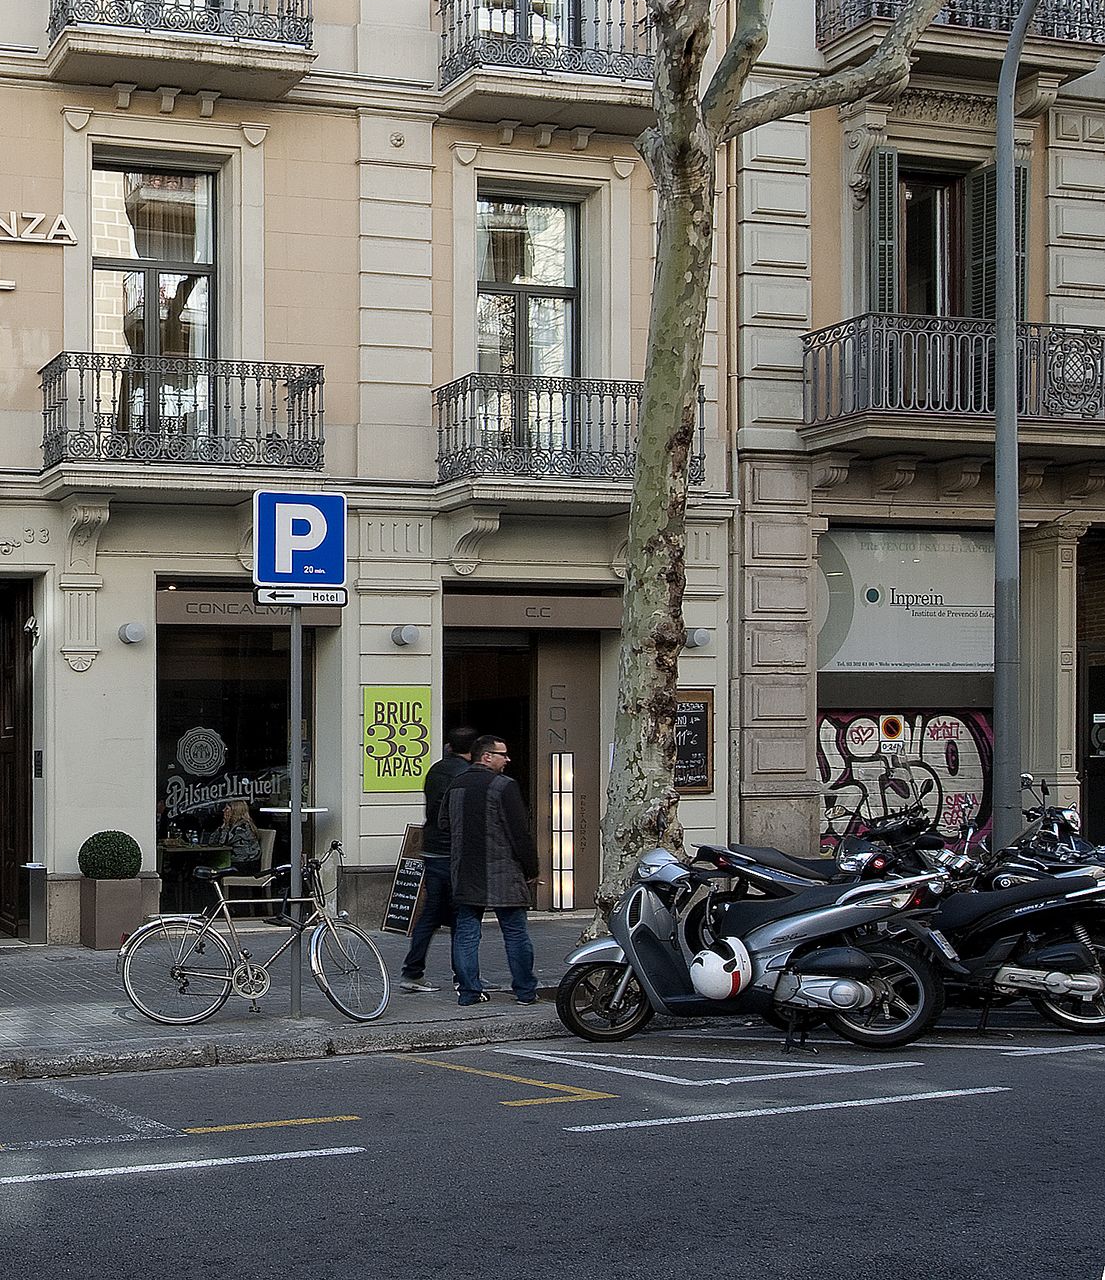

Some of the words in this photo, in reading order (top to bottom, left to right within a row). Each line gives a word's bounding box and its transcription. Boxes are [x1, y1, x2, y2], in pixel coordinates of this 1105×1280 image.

[23, 527, 50, 544] 33
[275, 503, 328, 574] P
[303, 565, 314, 574] 20
[312, 592, 339, 602] Hotel
[889, 587, 944, 610] Inprein
[911, 609, 937, 617] Institut
[947, 609, 978, 618] Prevenció
[374, 702, 423, 724] BRUC
[365, 723, 430, 759] 33
[374, 757, 423, 777] TAPAS
[165, 775, 227, 818] Pilsner
[225, 772, 282, 804] Urquell
